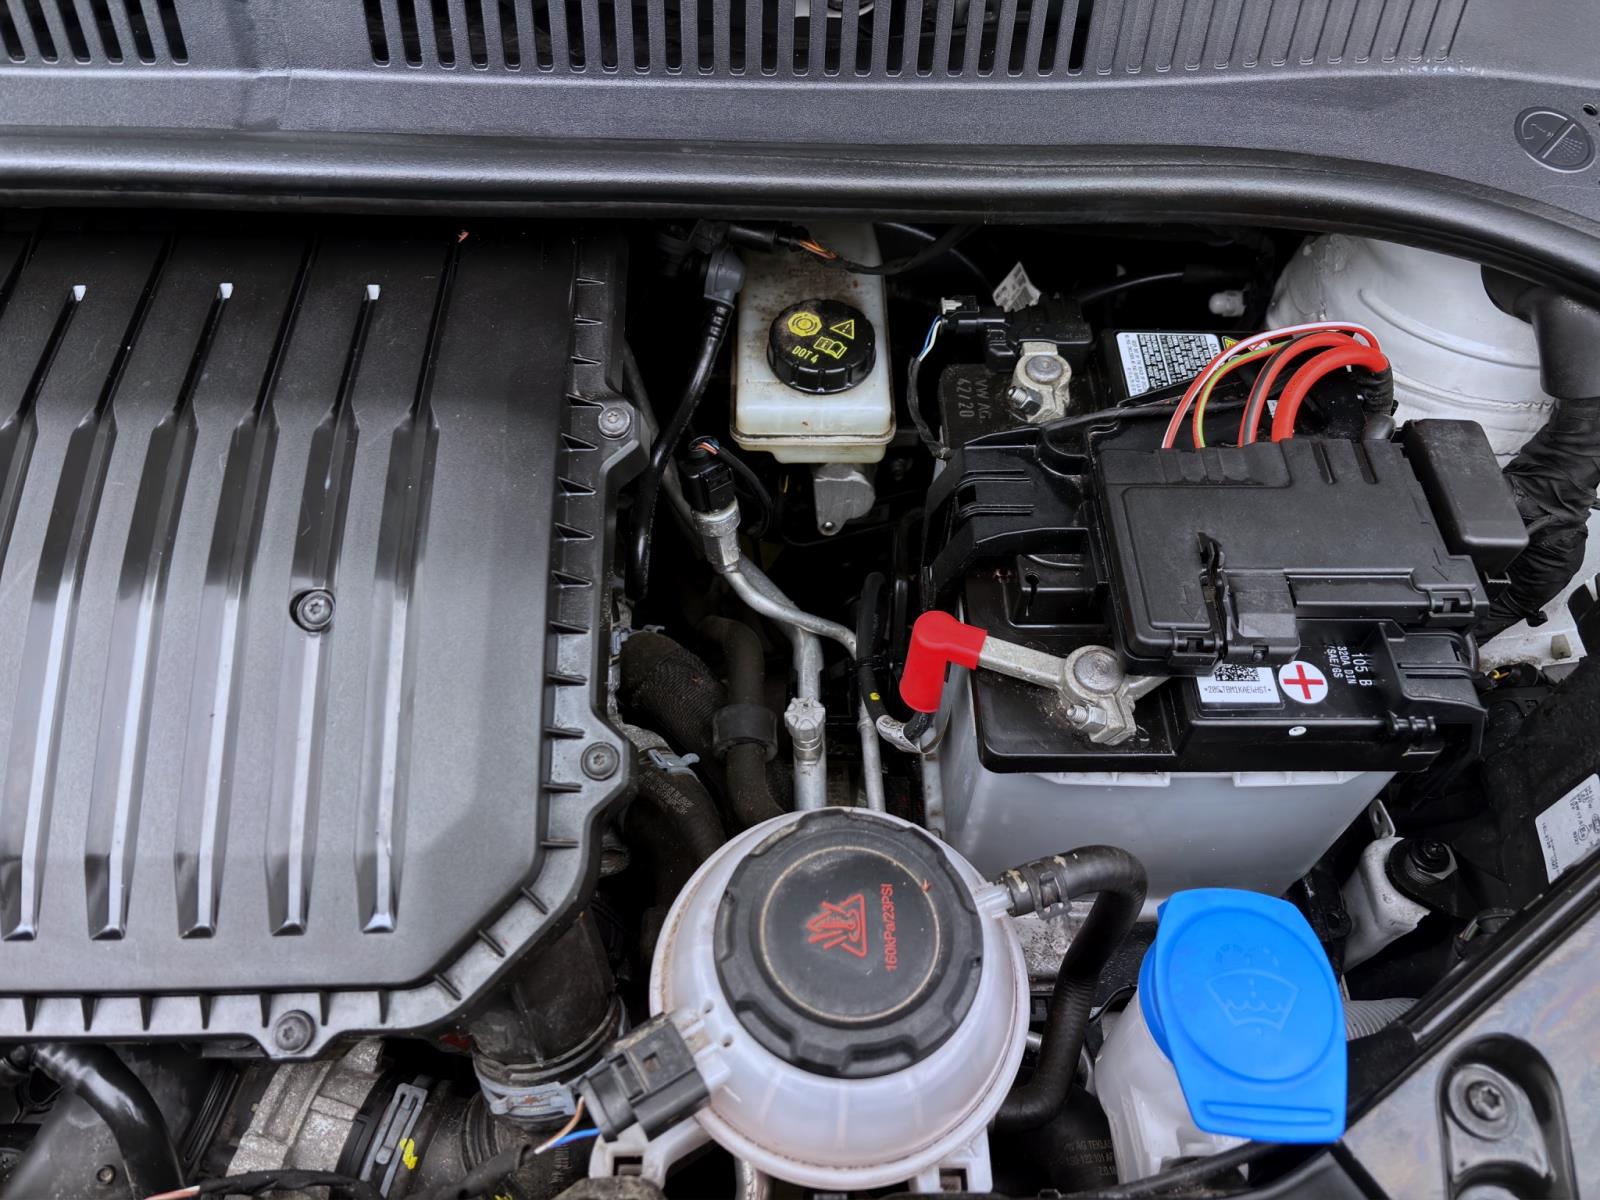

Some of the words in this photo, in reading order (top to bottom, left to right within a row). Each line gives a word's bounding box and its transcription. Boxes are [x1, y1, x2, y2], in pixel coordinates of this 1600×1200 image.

[792, 345, 813, 359] DOT
[810, 354, 820, 364] 4
[974, 378, 990, 399] VW
[1337, 646, 1351, 666] 320A
[1344, 669, 1358, 684] DIN
[1351, 653, 1369, 673] 105
[880, 883, 898, 972] 160kPa/23PSI
